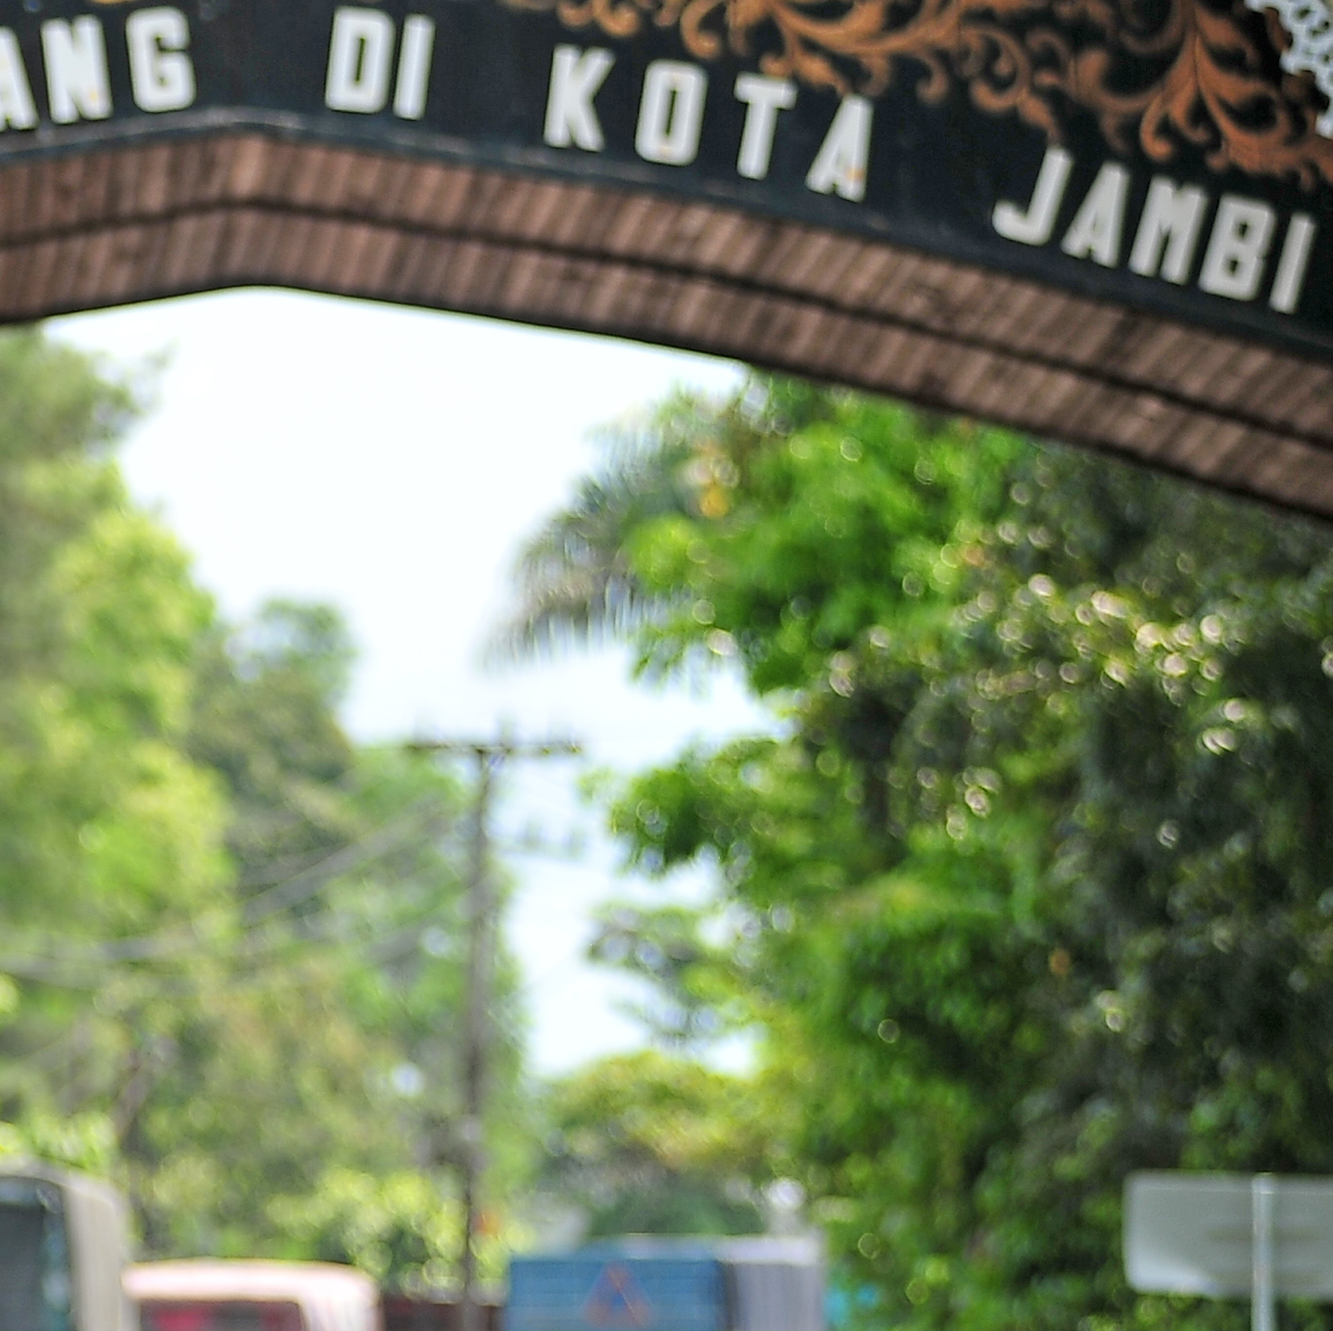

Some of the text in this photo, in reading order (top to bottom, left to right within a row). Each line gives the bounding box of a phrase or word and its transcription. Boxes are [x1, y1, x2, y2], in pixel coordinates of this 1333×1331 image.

[324, 7, 434, 120] DI
[543, 45, 873, 202] KOTA
[992, 147, 1312, 314] JAMBI
